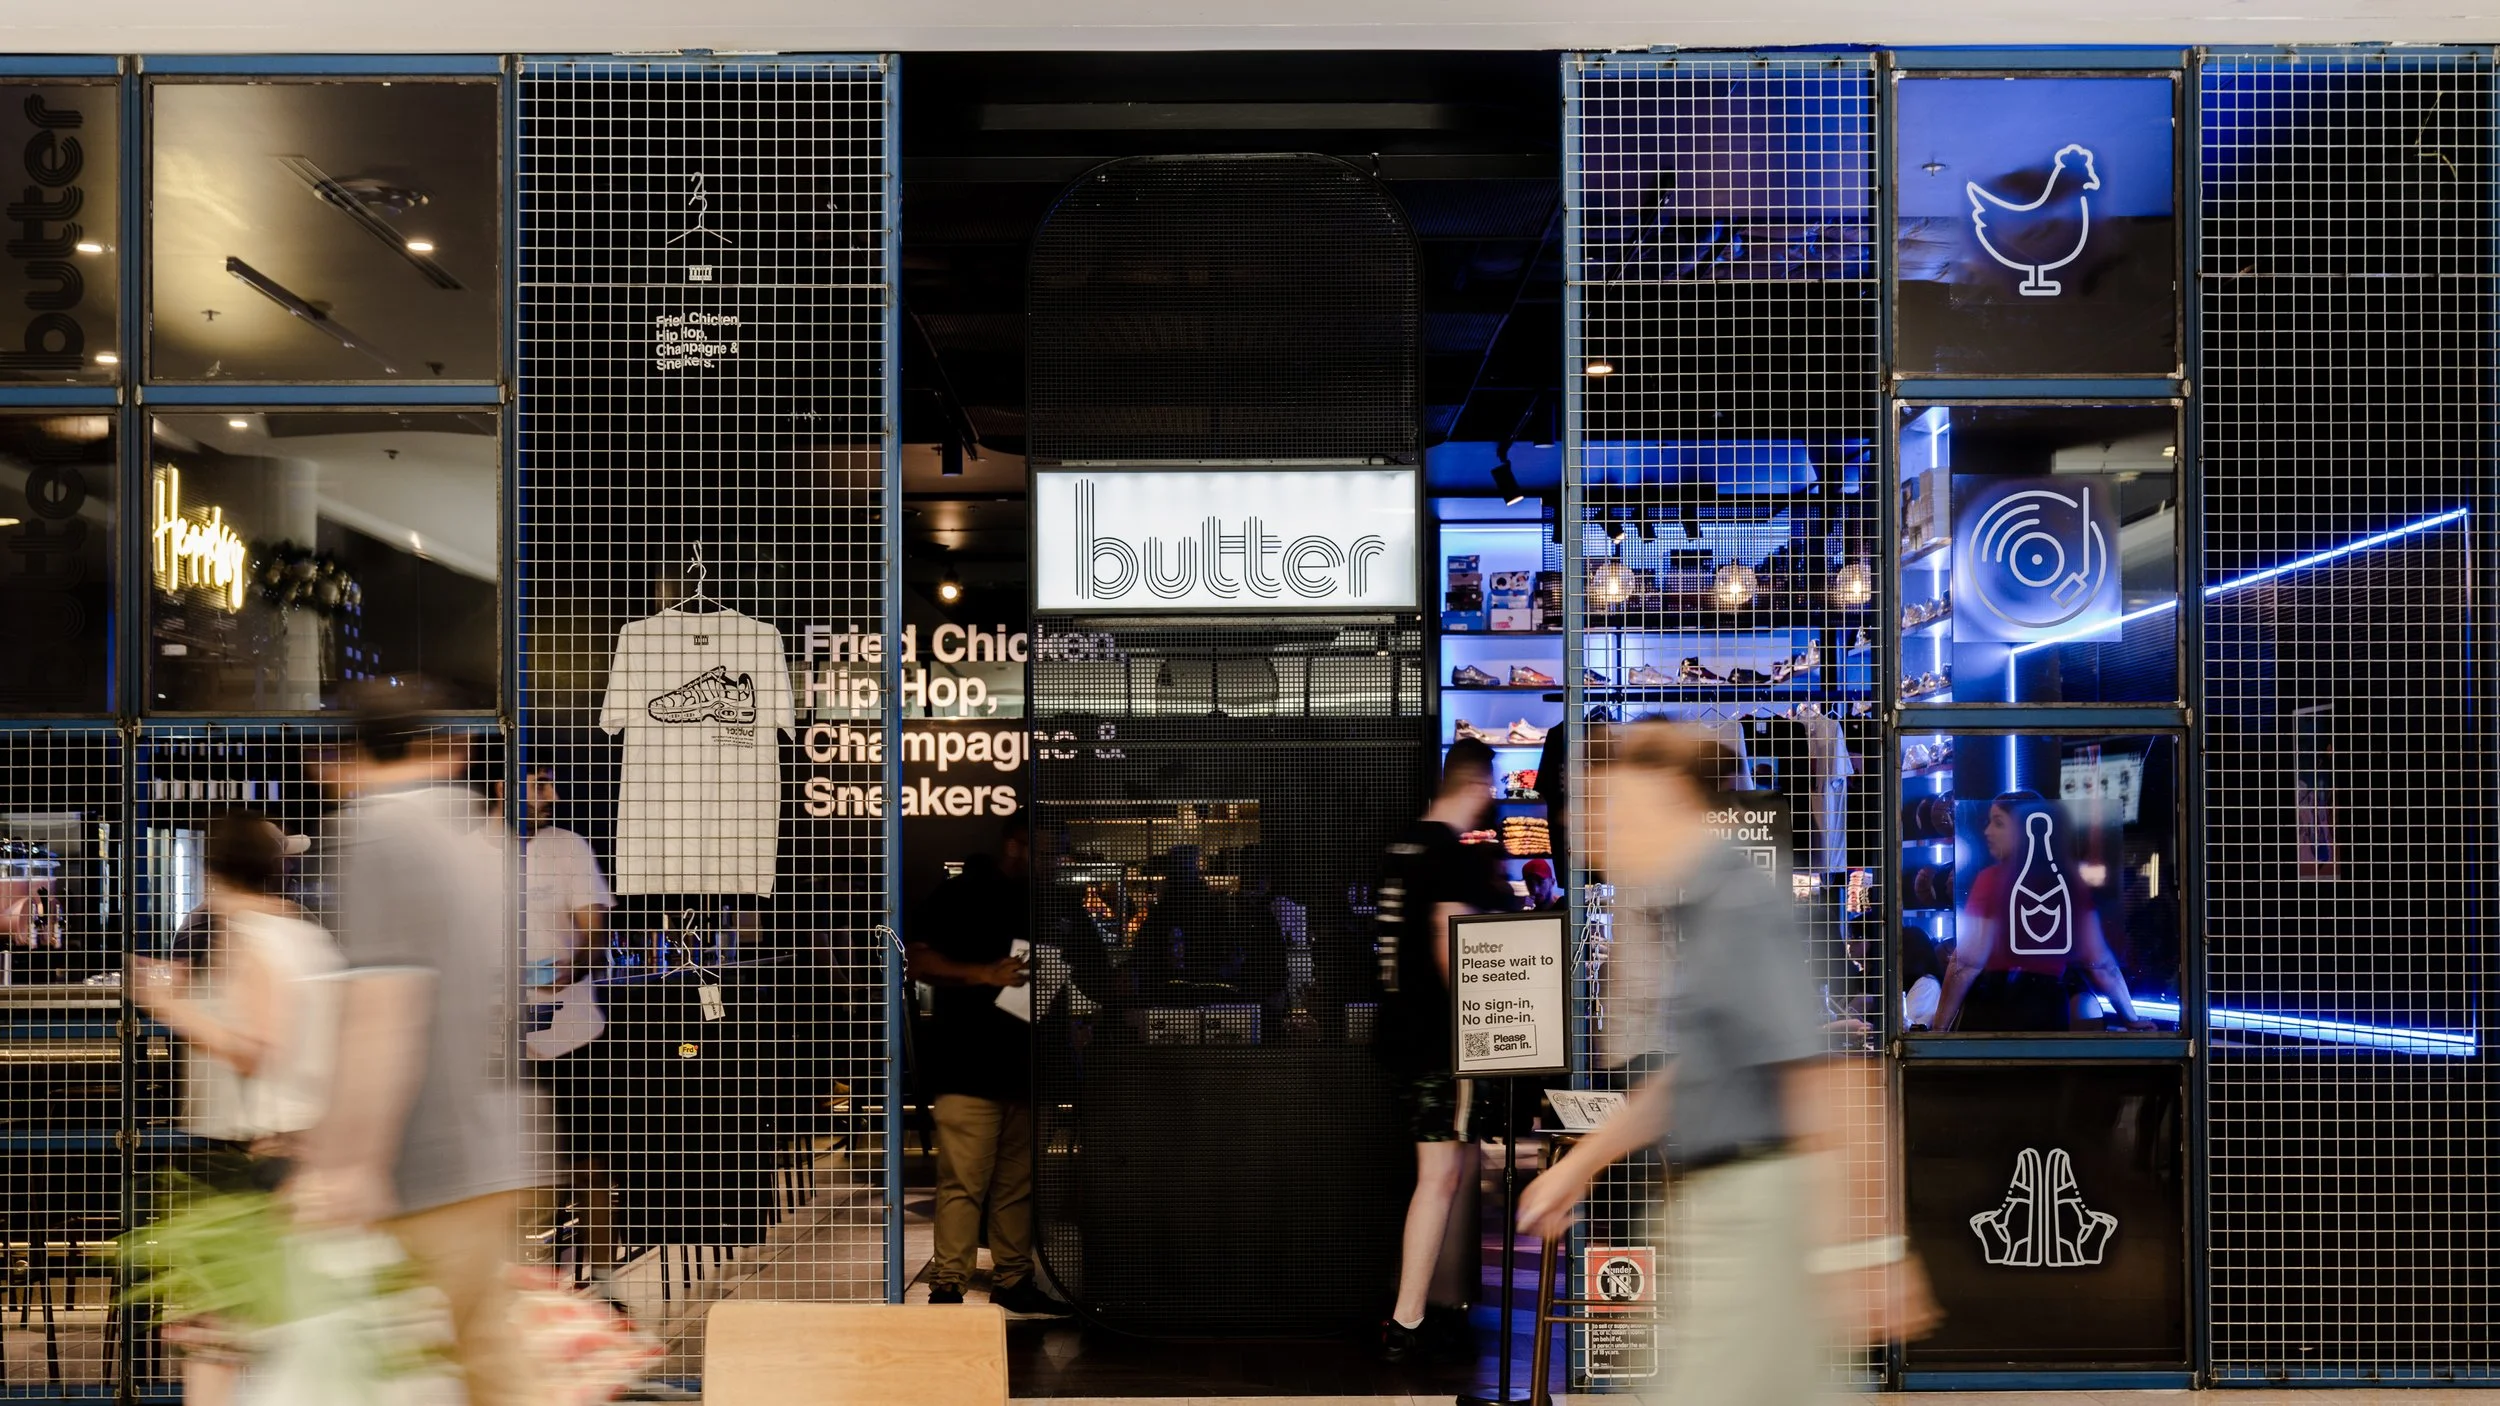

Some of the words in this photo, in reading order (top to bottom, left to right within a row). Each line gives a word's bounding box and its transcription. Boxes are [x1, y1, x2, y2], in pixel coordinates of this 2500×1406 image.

[0, 93, 84, 370] butter
[656, 312, 685, 328] Fried
[689, 311, 742, 328] Chicken,
[656, 329, 679, 344] Hip
[681, 326, 708, 342] Hop,
[656, 342, 727, 357] Champagne
[730, 341, 740, 354] &
[656, 354, 715, 371] Snekes.
[1075, 478, 1386, 600] butter
[804, 623, 917, 663] Fried
[932, 623, 1127, 664] Chicken,
[804, 665, 880, 718] Hip
[900, 668, 998, 716] Hop,
[804, 722, 1079, 772] Champagne
[1094, 721, 1127, 760] &
[1743, 810, 1777, 824] our
[1737, 825, 1774, 841] out.
[1461, 938, 1504, 955] butter
[1461, 957, 1506, 969] Please
[1509, 955, 1537, 967] wait
[1540, 956, 1554, 966] to
[1461, 972, 1478, 983] be
[1482, 969, 1530, 983] seated.
[1462, 1000, 1481, 1011] No
[1484, 997, 1534, 1012] sign-in,
[1462, 1014, 1481, 1025] No
[1484, 1012, 1535, 1025] dine-in.
[1493, 1033, 1526, 1043] Please
[1493, 1042, 1518, 1052] scan
[1520, 1040, 1532, 1050] in.
[1610, 1265, 1633, 1274] under
[1607, 1274, 1632, 1297] 18
